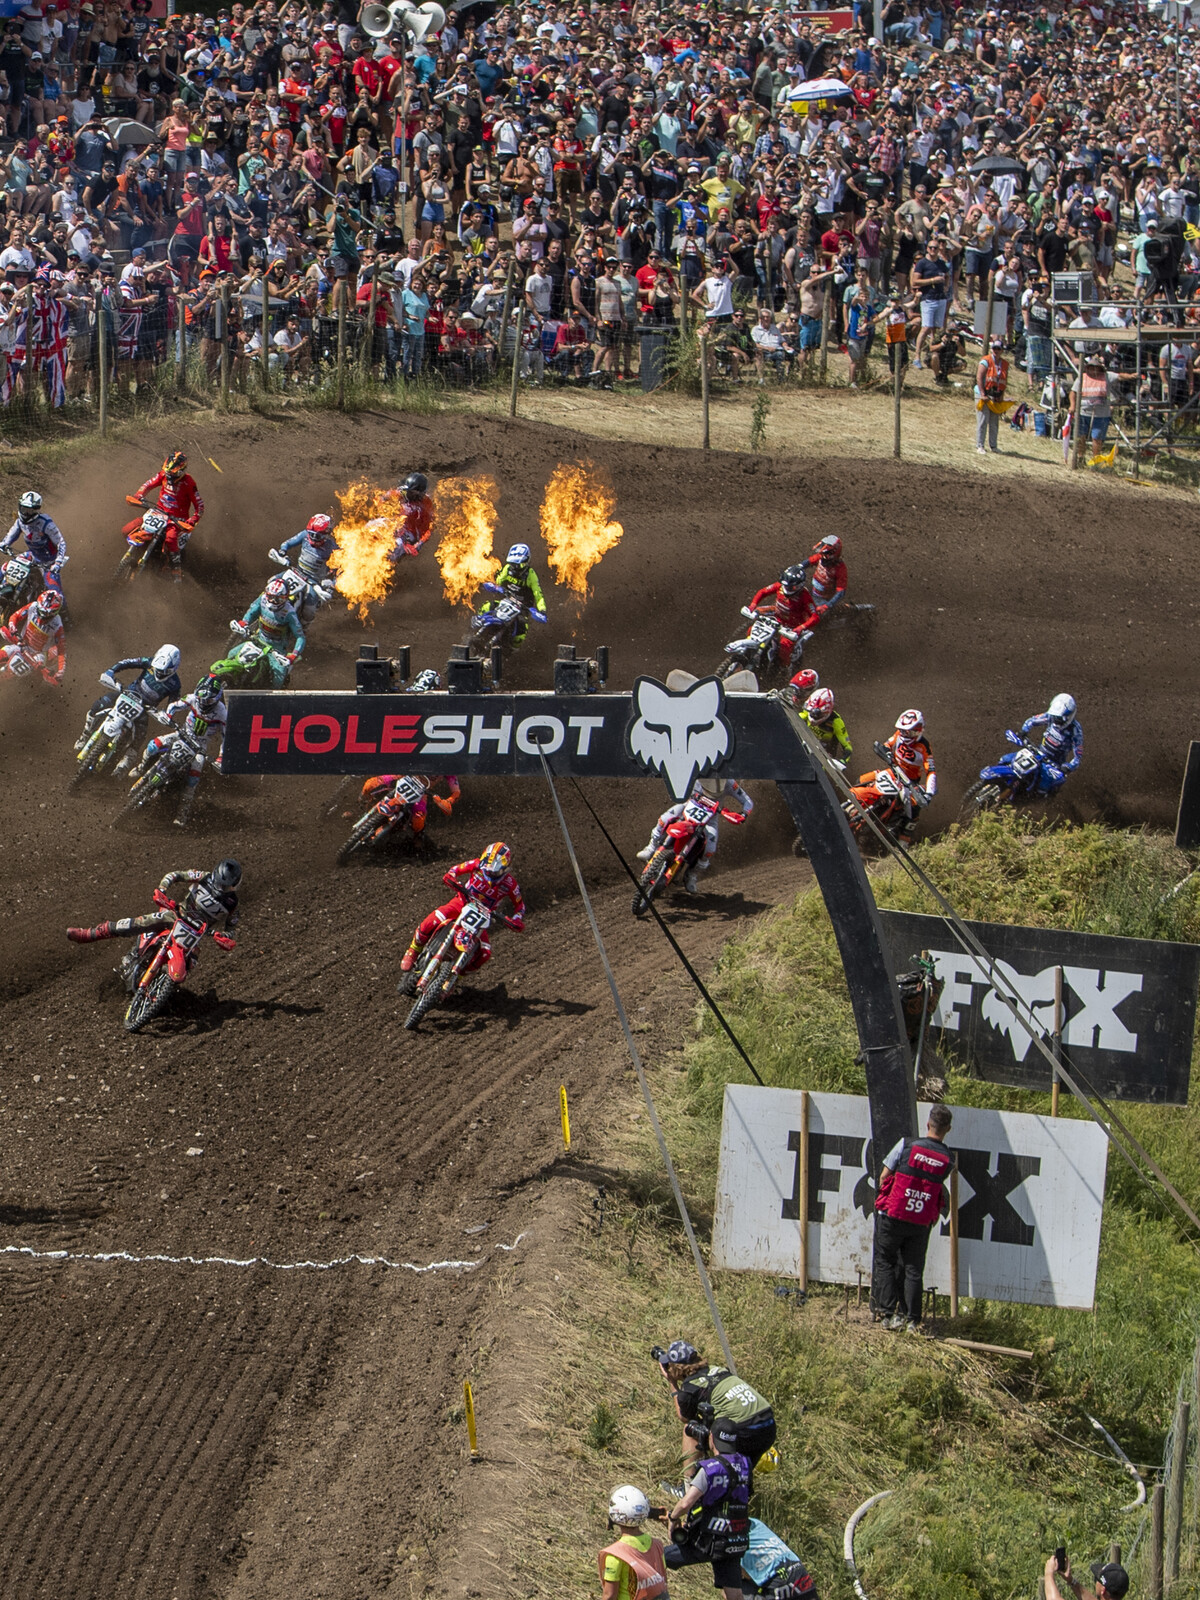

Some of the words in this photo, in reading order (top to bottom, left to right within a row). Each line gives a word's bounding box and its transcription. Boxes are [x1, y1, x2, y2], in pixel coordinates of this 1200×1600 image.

[144, 515, 165, 529] 260
[6, 566, 26, 581] 223
[117, 700, 140, 720] 189
[247, 714, 605, 756] HOLESHOT
[397, 782, 420, 802] 911
[686, 806, 708, 822] 43
[194, 888, 225, 917] FOX
[461, 909, 488, 929] 61
[174, 928, 197, 948] 70
[781, 1130, 1042, 1247] FX
[904, 1188, 932, 1202] STAFF
[905, 1199, 925, 1213] 59
[736, 1390, 756, 1407] 38
